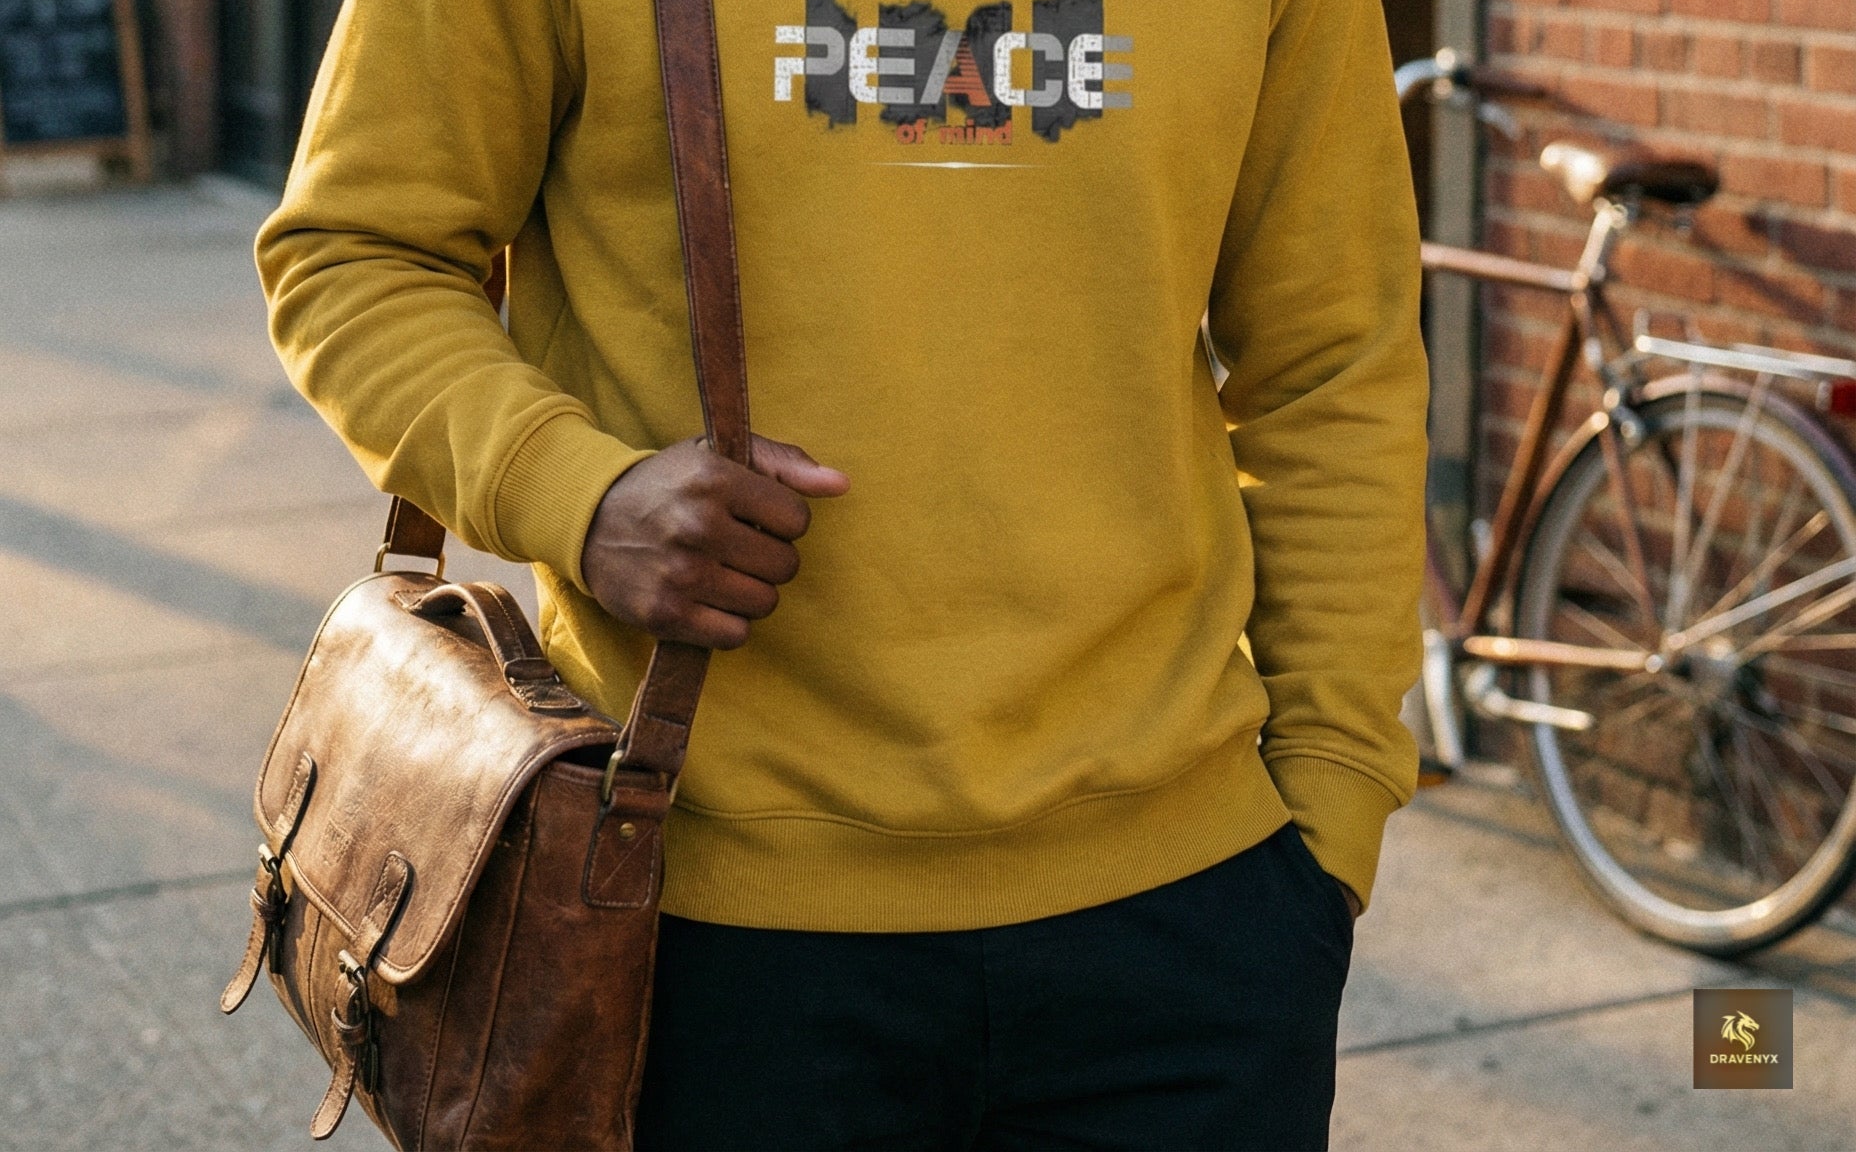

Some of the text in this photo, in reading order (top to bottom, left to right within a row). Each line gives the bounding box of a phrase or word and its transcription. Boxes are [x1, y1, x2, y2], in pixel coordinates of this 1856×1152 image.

[774, 25, 1134, 109] PEACE
[896, 119, 1013, 145] of mind
